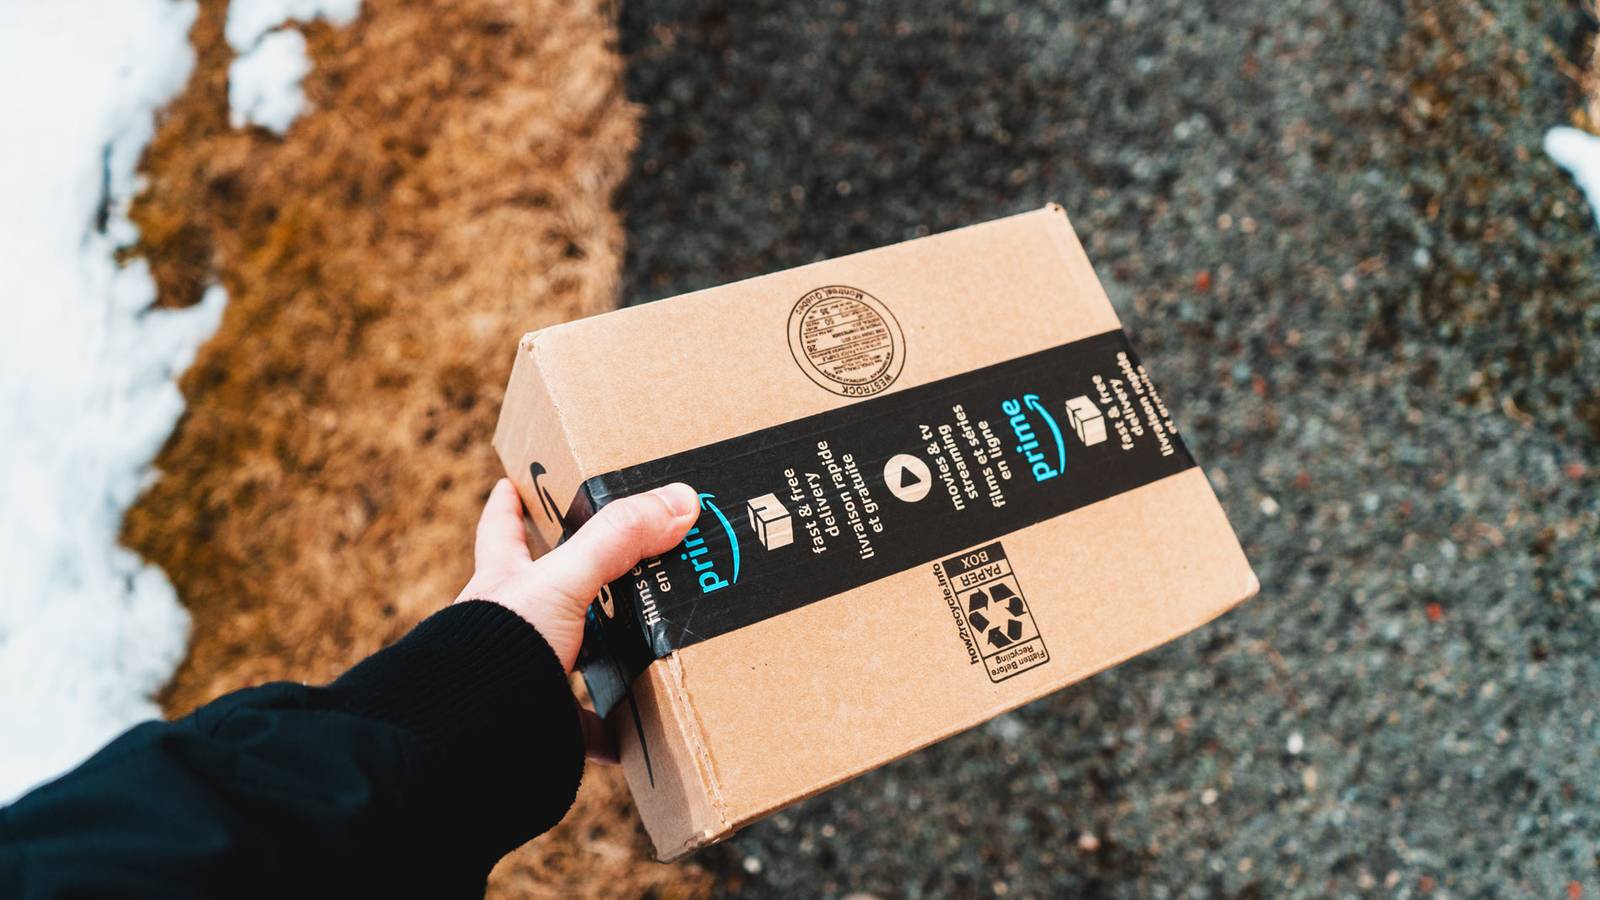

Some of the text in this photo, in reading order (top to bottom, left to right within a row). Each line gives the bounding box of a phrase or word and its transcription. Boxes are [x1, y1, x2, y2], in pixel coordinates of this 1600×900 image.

[841, 374, 893, 395] WESTROCK
[1092, 374, 1113, 404] free
[1109, 378, 1144, 436] delivery
[1117, 351, 1175, 457] livraison rapide
[938, 424, 979, 500] streaming
[952, 404, 1006, 508] films et séries
[978, 420, 1012, 480] en ligne
[1002, 399, 1058, 482] prime
[1115, 420, 1134, 450] fast
[842, 453, 884, 533] et gratuite
[918, 424, 966, 511] movies & tv
[784, 468, 827, 554] fast & free
[804, 472, 840, 537] delivery
[817, 440, 875, 560] livraison rapide
[655, 570, 672, 592] en
[959, 563, 1002, 587] PAPER
[960, 551, 989, 569] BOX
[636, 579, 661, 626] films
[932, 563, 980, 665] how2recycle.info
[991, 649, 1046, 676] Flatten Before
[995, 644, 1034, 664] Recycling
